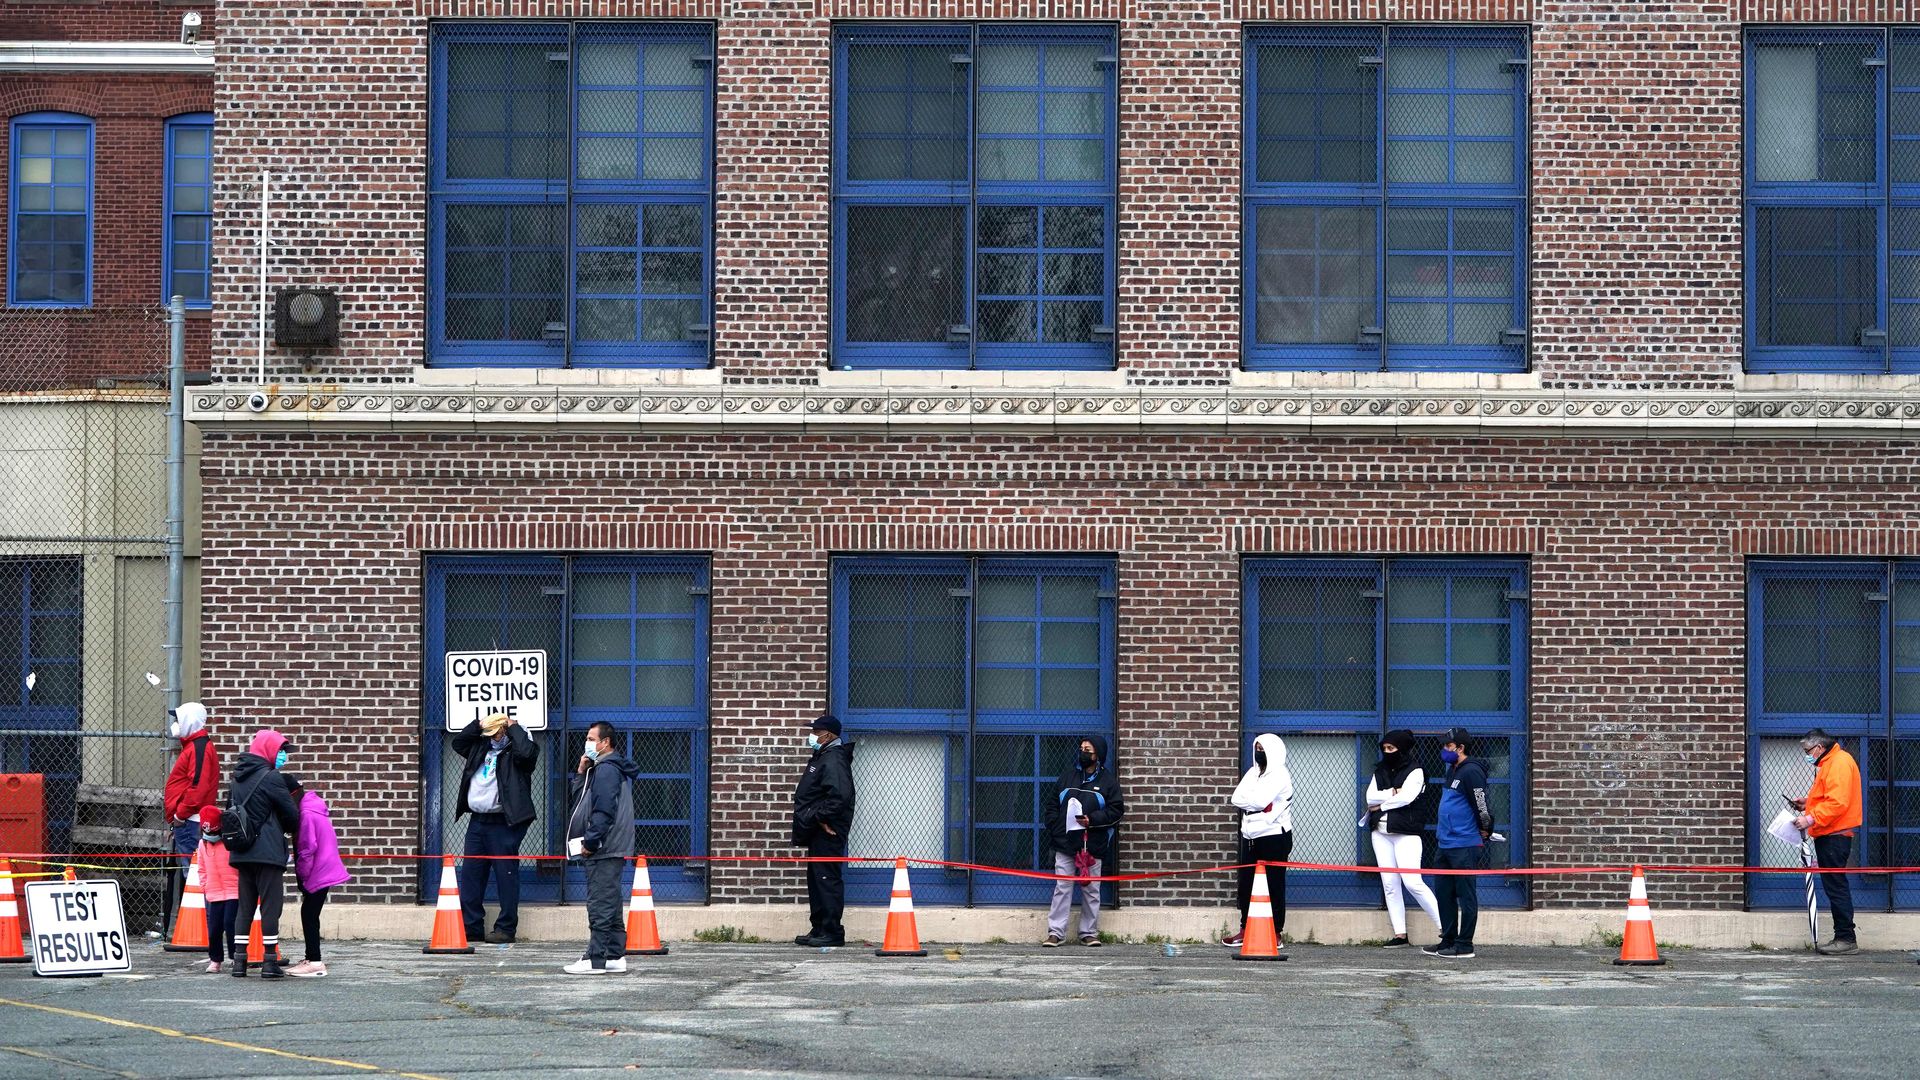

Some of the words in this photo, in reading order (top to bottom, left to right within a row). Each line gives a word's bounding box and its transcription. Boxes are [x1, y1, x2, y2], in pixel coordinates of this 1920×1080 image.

[452, 656, 539, 677] COVID-19
[454, 682, 538, 702] TESTING
[50, 891, 98, 921] TEST
[38, 930, 124, 963] RESULTS
